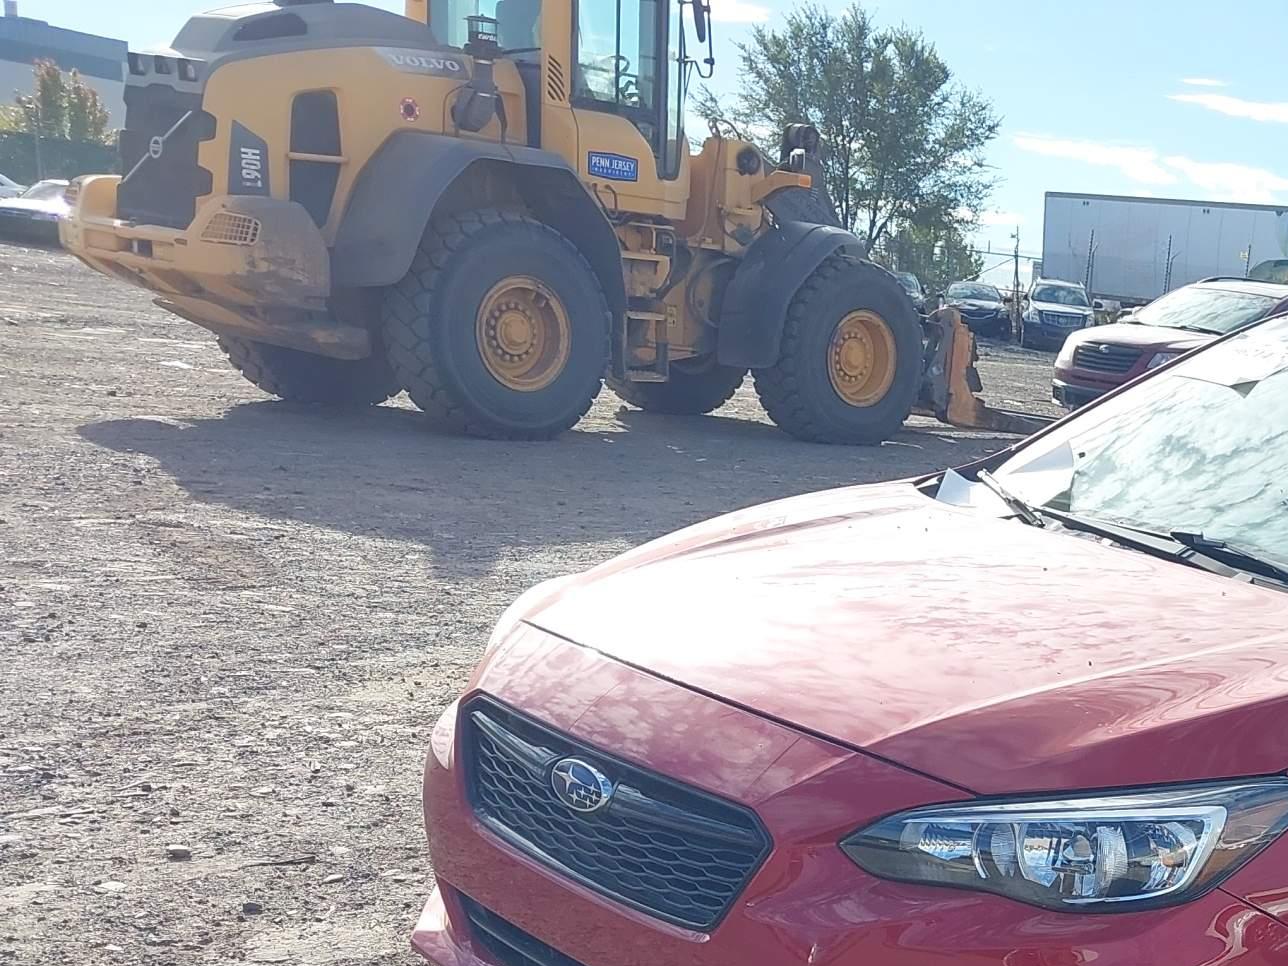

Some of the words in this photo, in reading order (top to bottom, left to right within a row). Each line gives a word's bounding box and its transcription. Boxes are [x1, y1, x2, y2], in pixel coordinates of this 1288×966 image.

[390, 55, 460, 71] VOLVO
[591, 156, 610, 168] PENN
[611, 160, 635, 171] JERSEY
